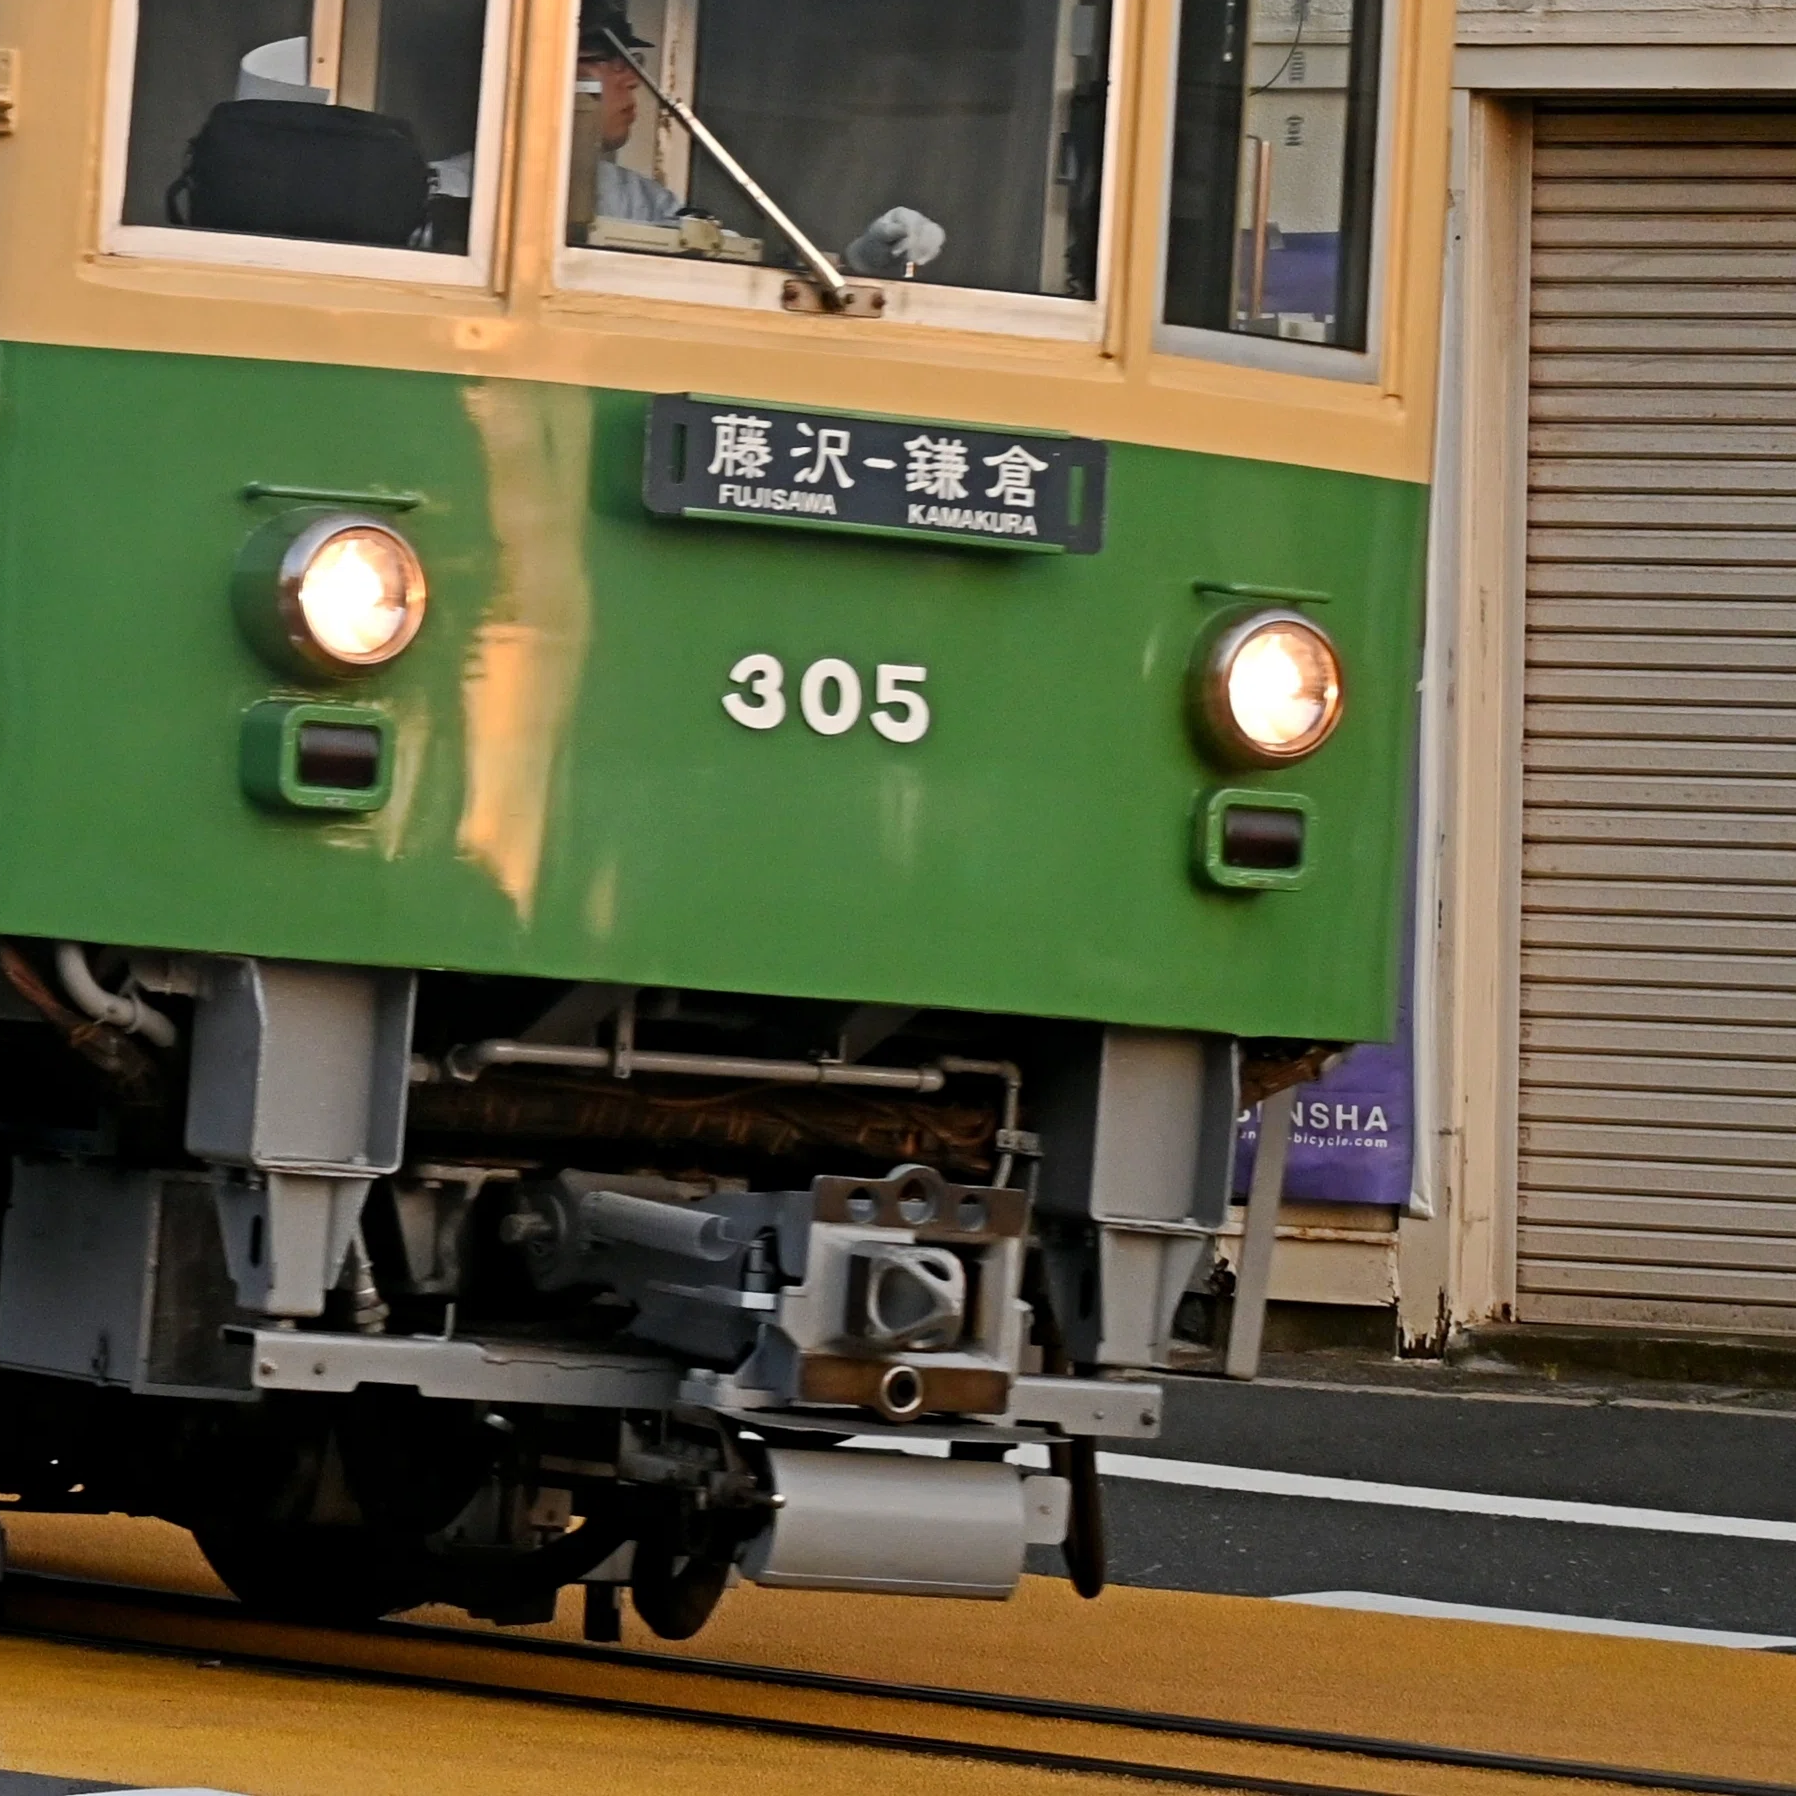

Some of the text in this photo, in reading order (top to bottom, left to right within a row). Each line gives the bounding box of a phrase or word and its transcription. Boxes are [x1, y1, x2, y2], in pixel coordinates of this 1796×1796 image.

[718, 483, 1038, 536] FUJISAWA KAMAKURA
[721, 653, 931, 743] 305
[1237, 1100, 1389, 1133] NSHA
